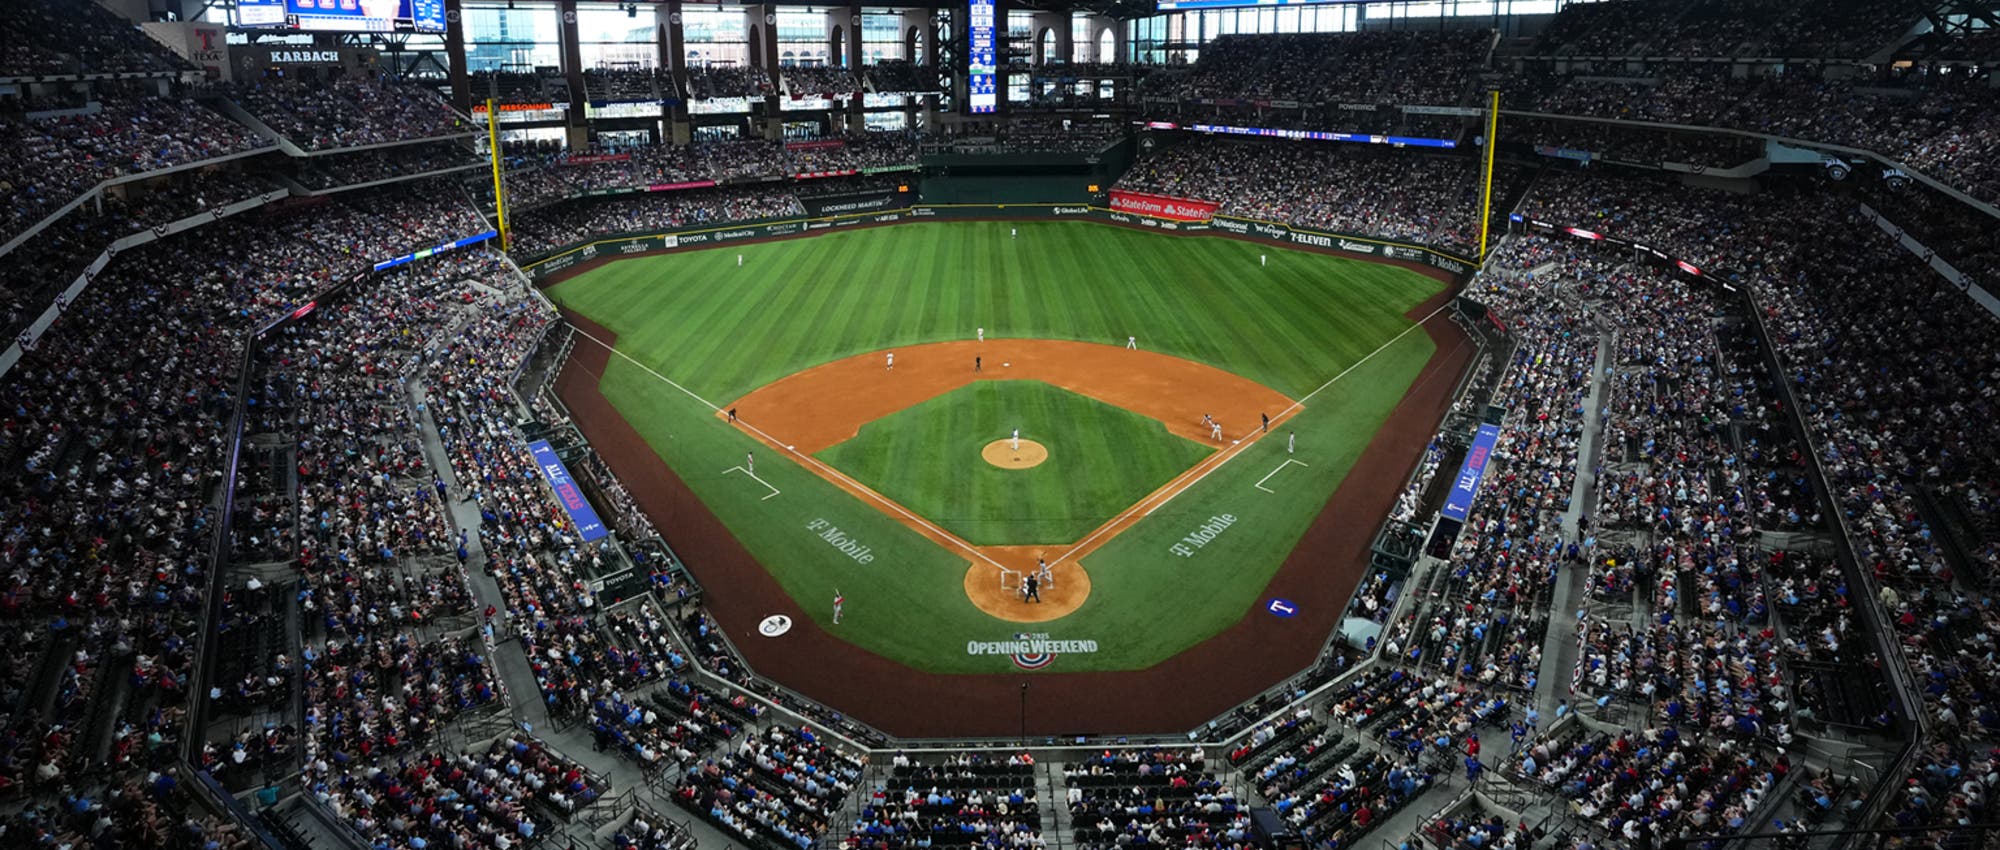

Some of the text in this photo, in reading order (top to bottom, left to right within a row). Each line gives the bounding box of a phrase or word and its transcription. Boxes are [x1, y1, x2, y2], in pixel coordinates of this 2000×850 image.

[271, 51, 338, 62] KARBACH
[500, 103, 552, 111] PERSONNEL
[821, 200, 883, 213] LOCKHEED MARTIN
[679, 235, 707, 243] TOYOTA
[545, 463, 563, 479] ALL
[558, 483, 584, 511] TEXAS
[1458, 475, 1476, 492] ALL
[606, 571, 634, 586] TOYOTA
